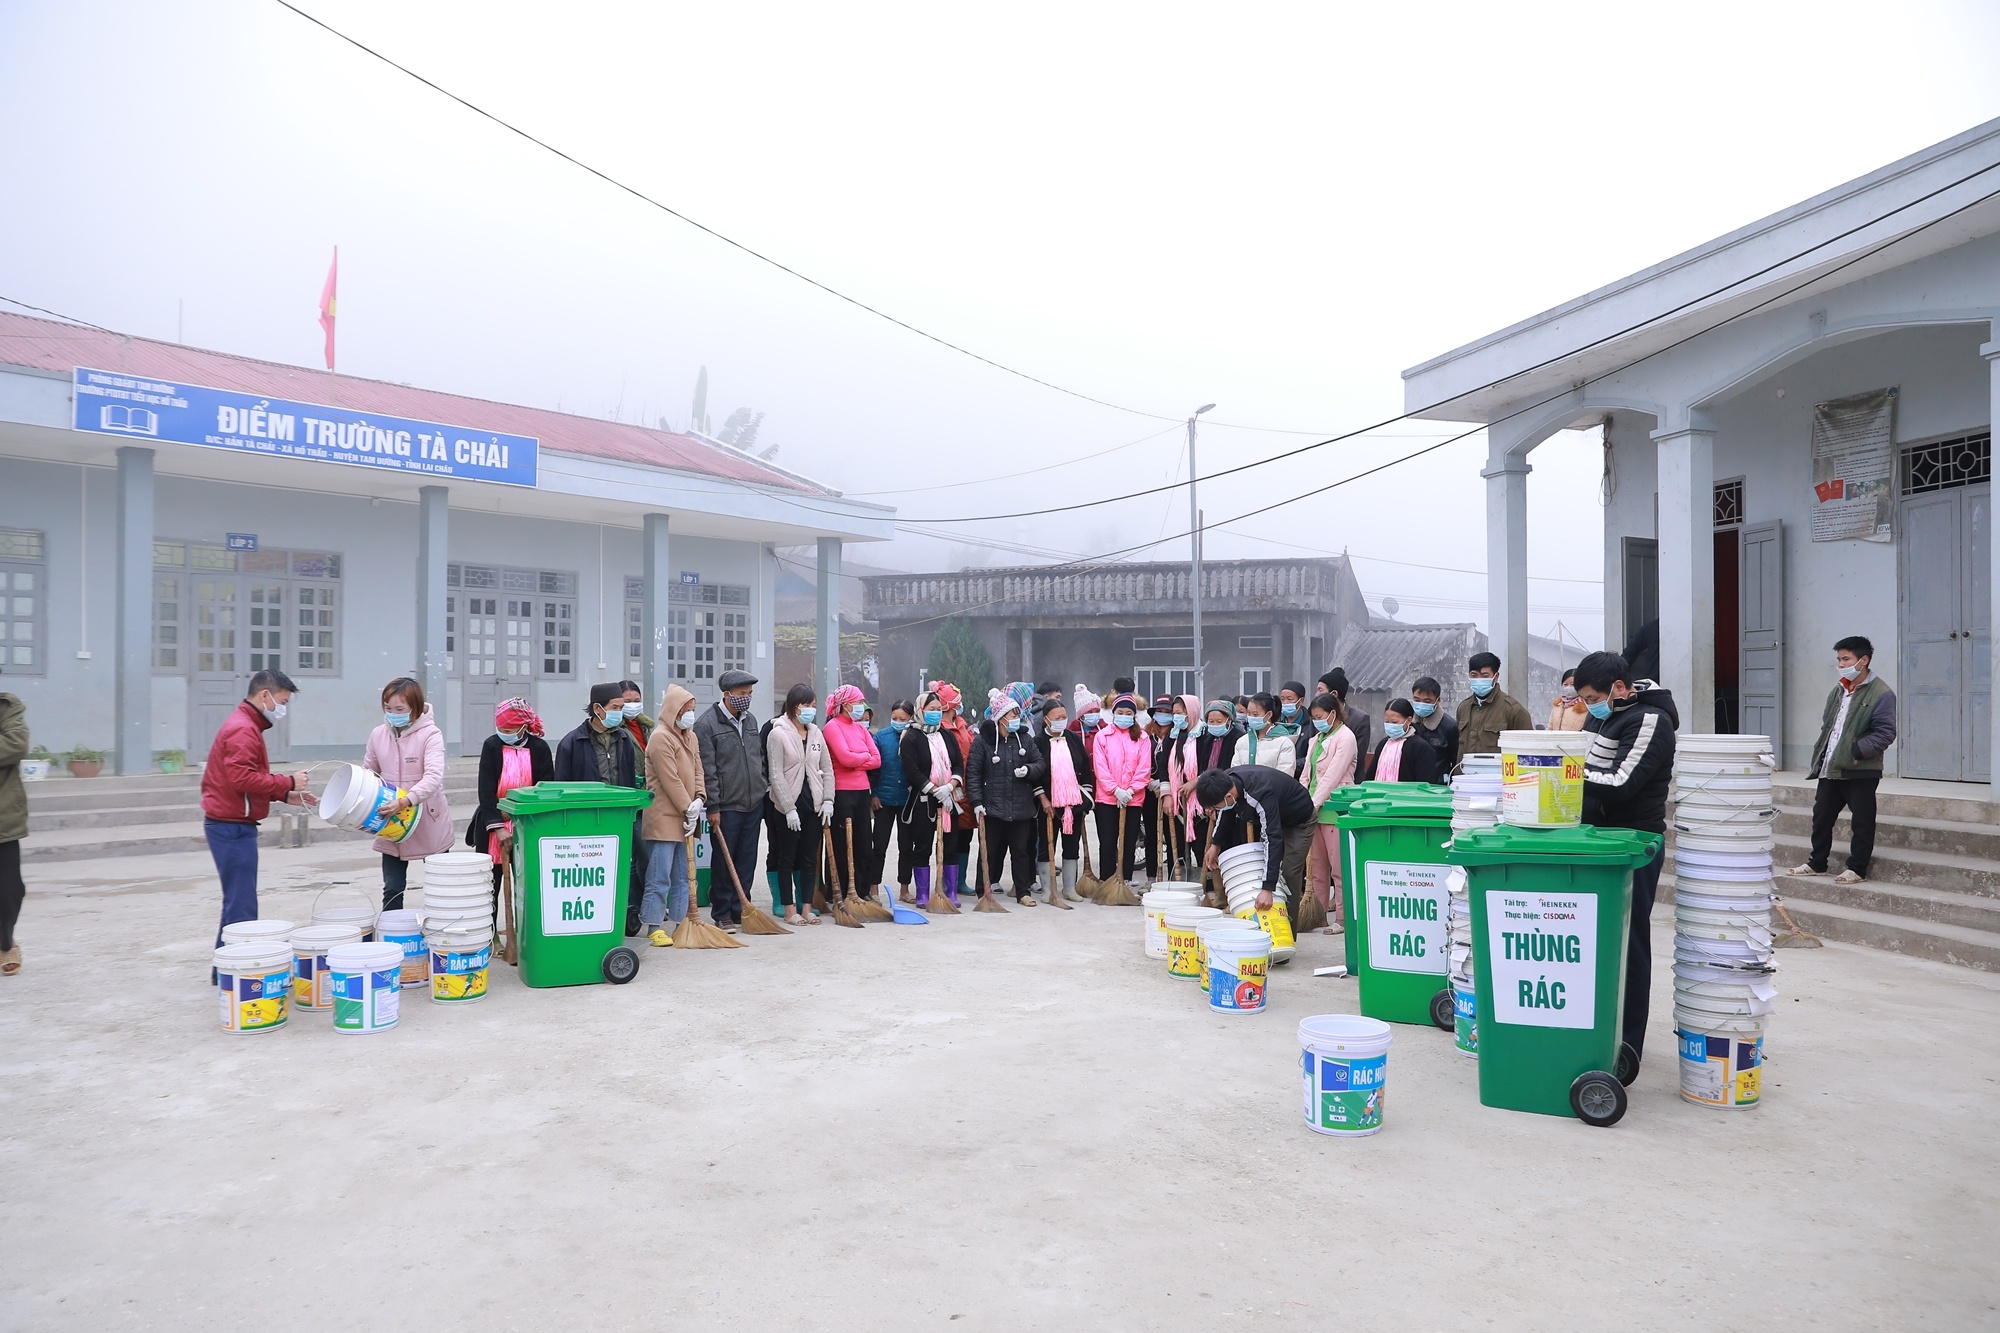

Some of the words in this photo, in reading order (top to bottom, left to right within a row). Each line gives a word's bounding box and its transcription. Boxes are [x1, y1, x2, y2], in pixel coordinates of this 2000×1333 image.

[217, 400, 294, 441] ĐIỂM
[303, 417, 411, 457] TRƯỜNG
[418, 431, 448, 461] TÀ
[454, 437, 509, 469] CHẢI
[245, 439, 255, 448] TÀ
[360, 455, 376, 464] TAM
[422, 463, 433, 471] LAI
[247, 540, 254, 548] 2
[551, 863, 605, 888] THÙNG
[562, 896, 594, 921] RÁC
[1378, 892, 1438, 921] THÙNG
[1504, 899, 1515, 907] Tài
[1515, 899, 1528, 908] trợ:
[1505, 911, 1521, 920] Thực
[1522, 912, 1541, 920] hiện:
[1543, 912, 1575, 920] CISDOMA
[1184, 937, 1195, 948] CƠ
[1389, 929, 1426, 958] RÁC
[1502, 927, 1580, 963] THÙNG
[450, 957, 467, 970] RÁC
[1241, 961, 1258, 975] RÁC
[266, 979, 282, 994] RÁC
[1518, 975, 1566, 1010] RÁC
[1459, 998, 1474, 1015] RÁC
[1689, 1041, 1702, 1057] CƠ
[1353, 1066, 1373, 1085] RÁC
